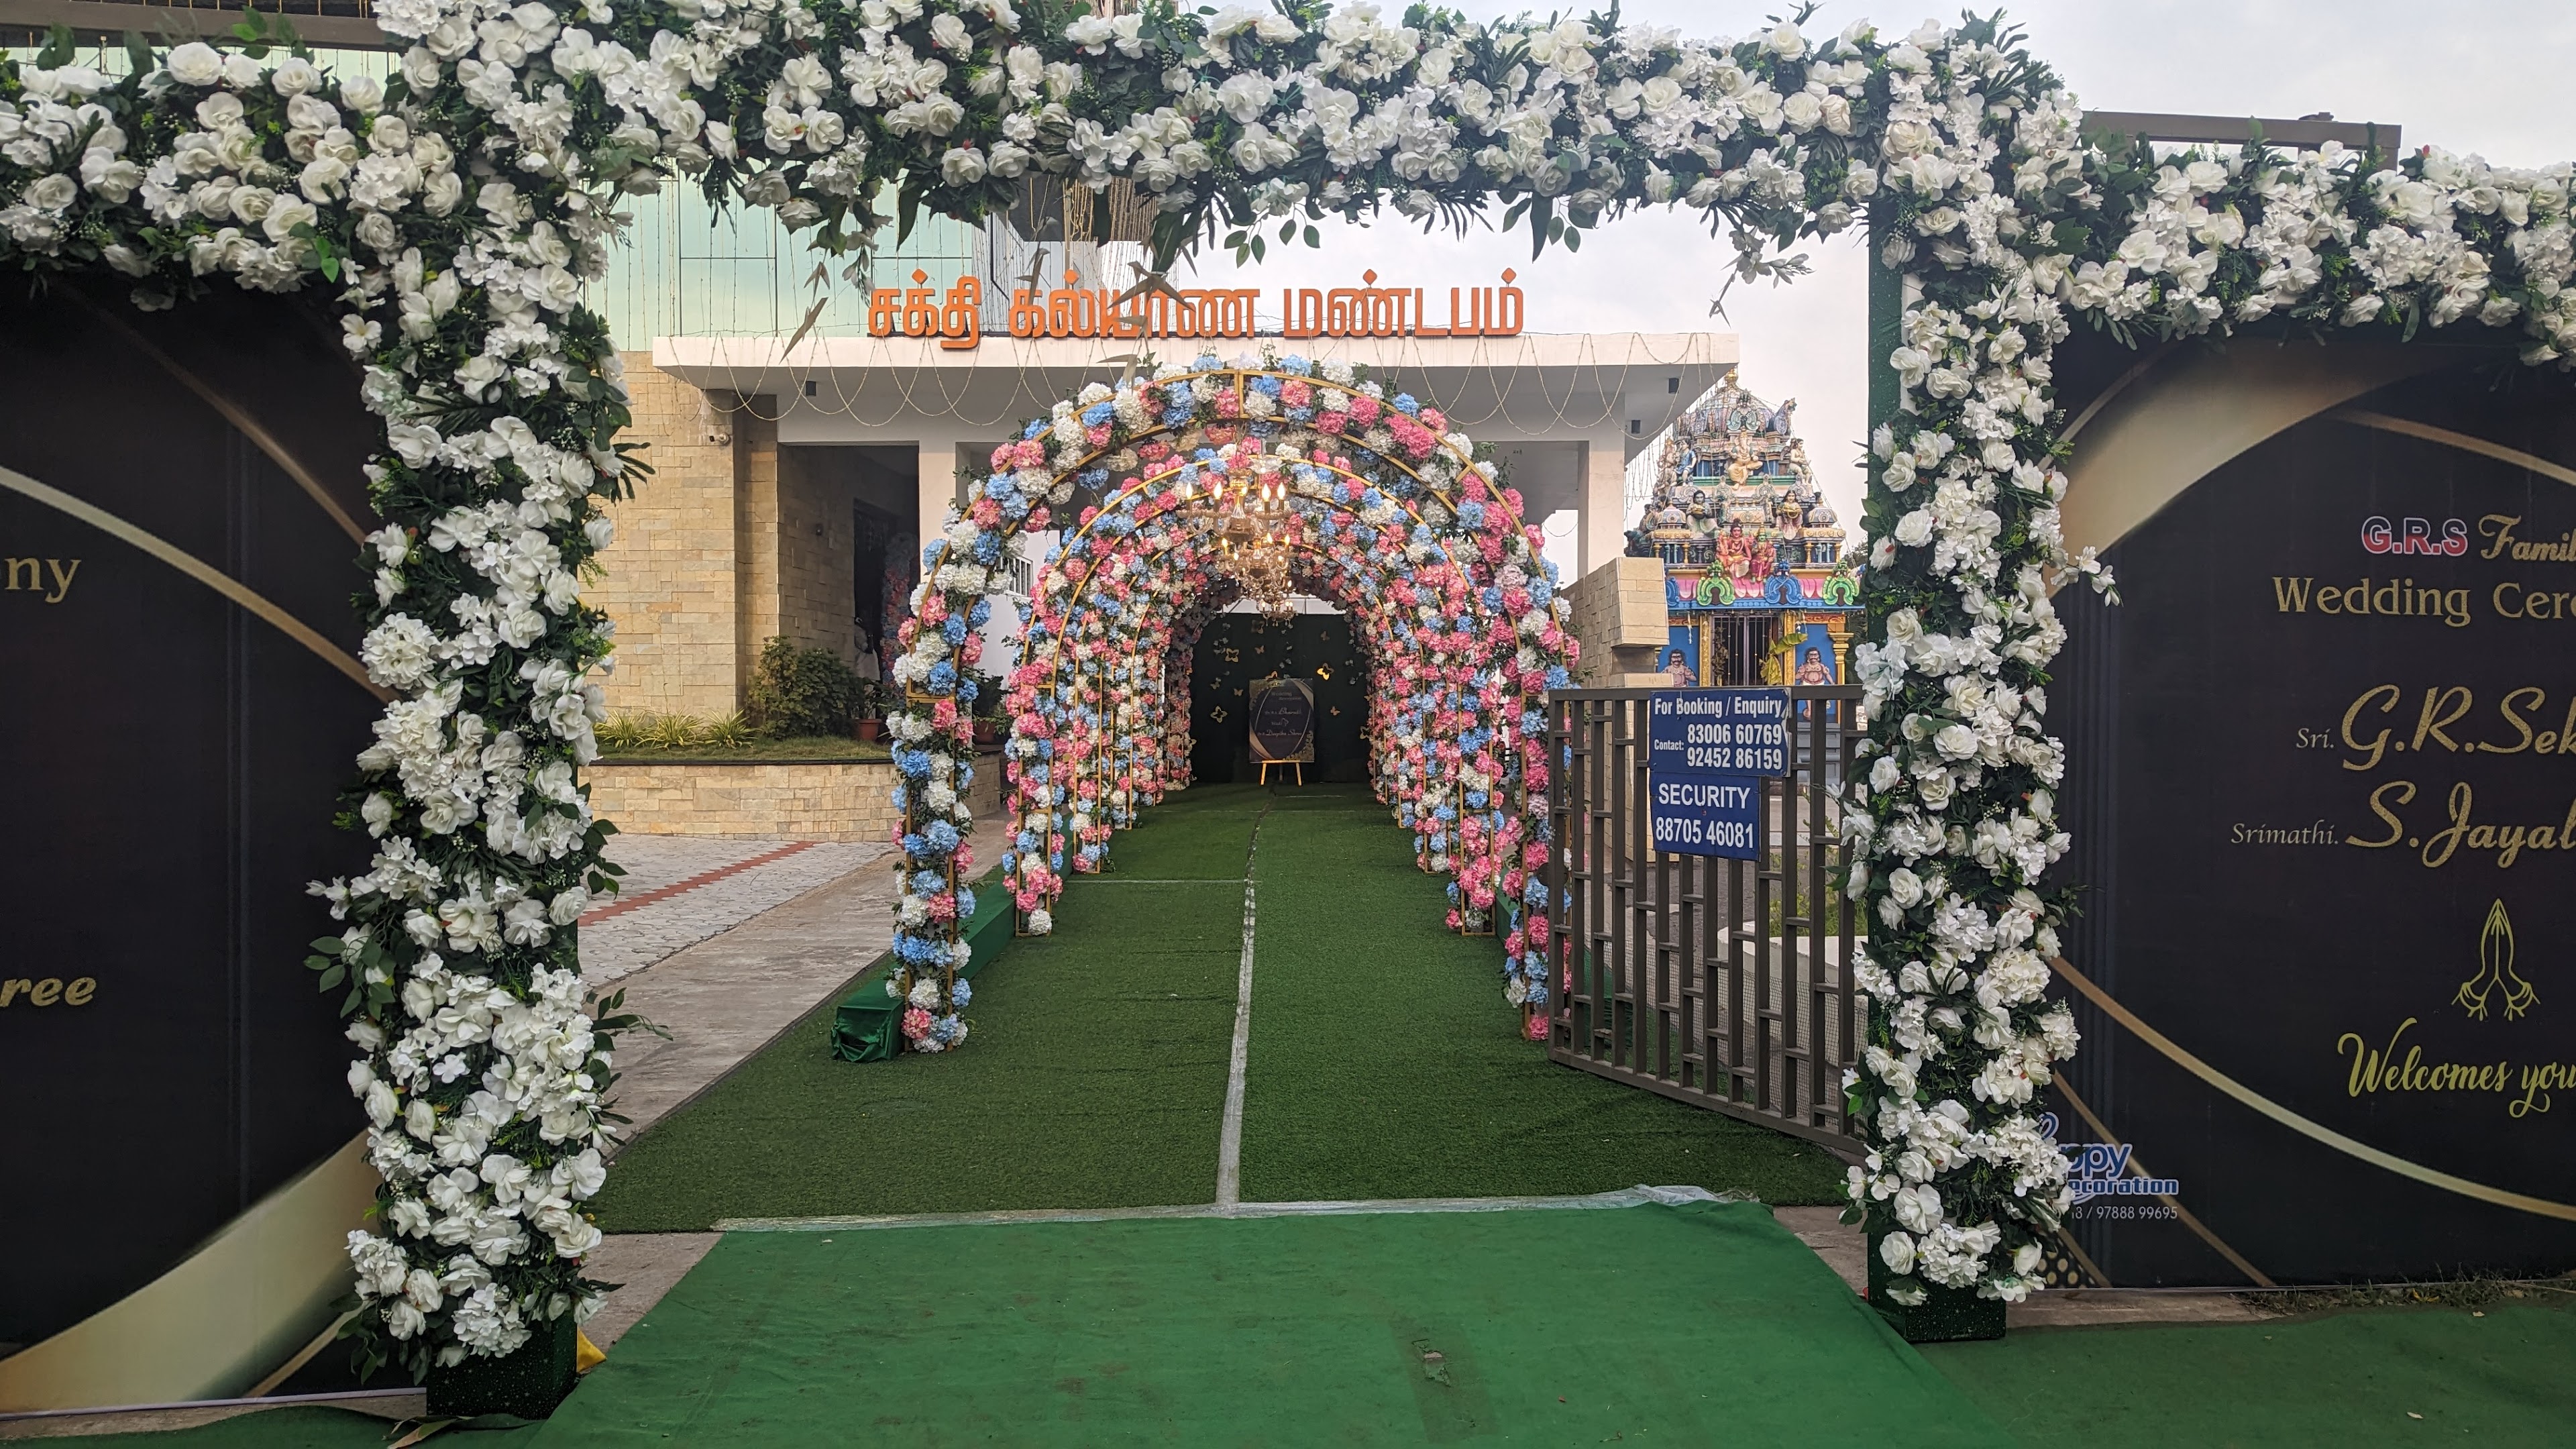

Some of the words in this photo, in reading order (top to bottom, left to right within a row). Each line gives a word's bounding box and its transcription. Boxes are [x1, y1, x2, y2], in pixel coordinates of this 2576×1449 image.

[869, 268, 981, 350] சக்தி
[1009, 269, 1260, 337] கல்யாண
[1283, 268, 1523, 337] மண்டபம்
[2361, 515, 2468, 556] G.R.S
[2272, 576, 2471, 627] Wedding
[2493, 582, 2576, 619] Cer
[1654, 698, 1676, 715] For
[1676, 698, 1723, 718] Booking
[1725, 696, 1731, 716] /
[1734, 696, 1782, 718] Enquiry
[1654, 739, 1684, 751] Contact:
[1687, 724, 1731, 745] 83006
[1735, 724, 1782, 745] 60769
[2296, 727, 2334, 749] Sri.
[1687, 747, 1731, 768] 92452
[1735, 748, 1782, 769] 86159
[1658, 783, 1750, 809] SECURITY
[1656, 816, 1702, 844] 88705
[1706, 820, 1753, 849] 46081
[2231, 819, 2339, 845] Srimathi.
[2337, 1017, 2513, 1097] Welcomes
[2068, 1176, 2180, 1195] ecoration
[2096, 1205, 2135, 1220] 97888
[2139, 1206, 2178, 1220] 99695
